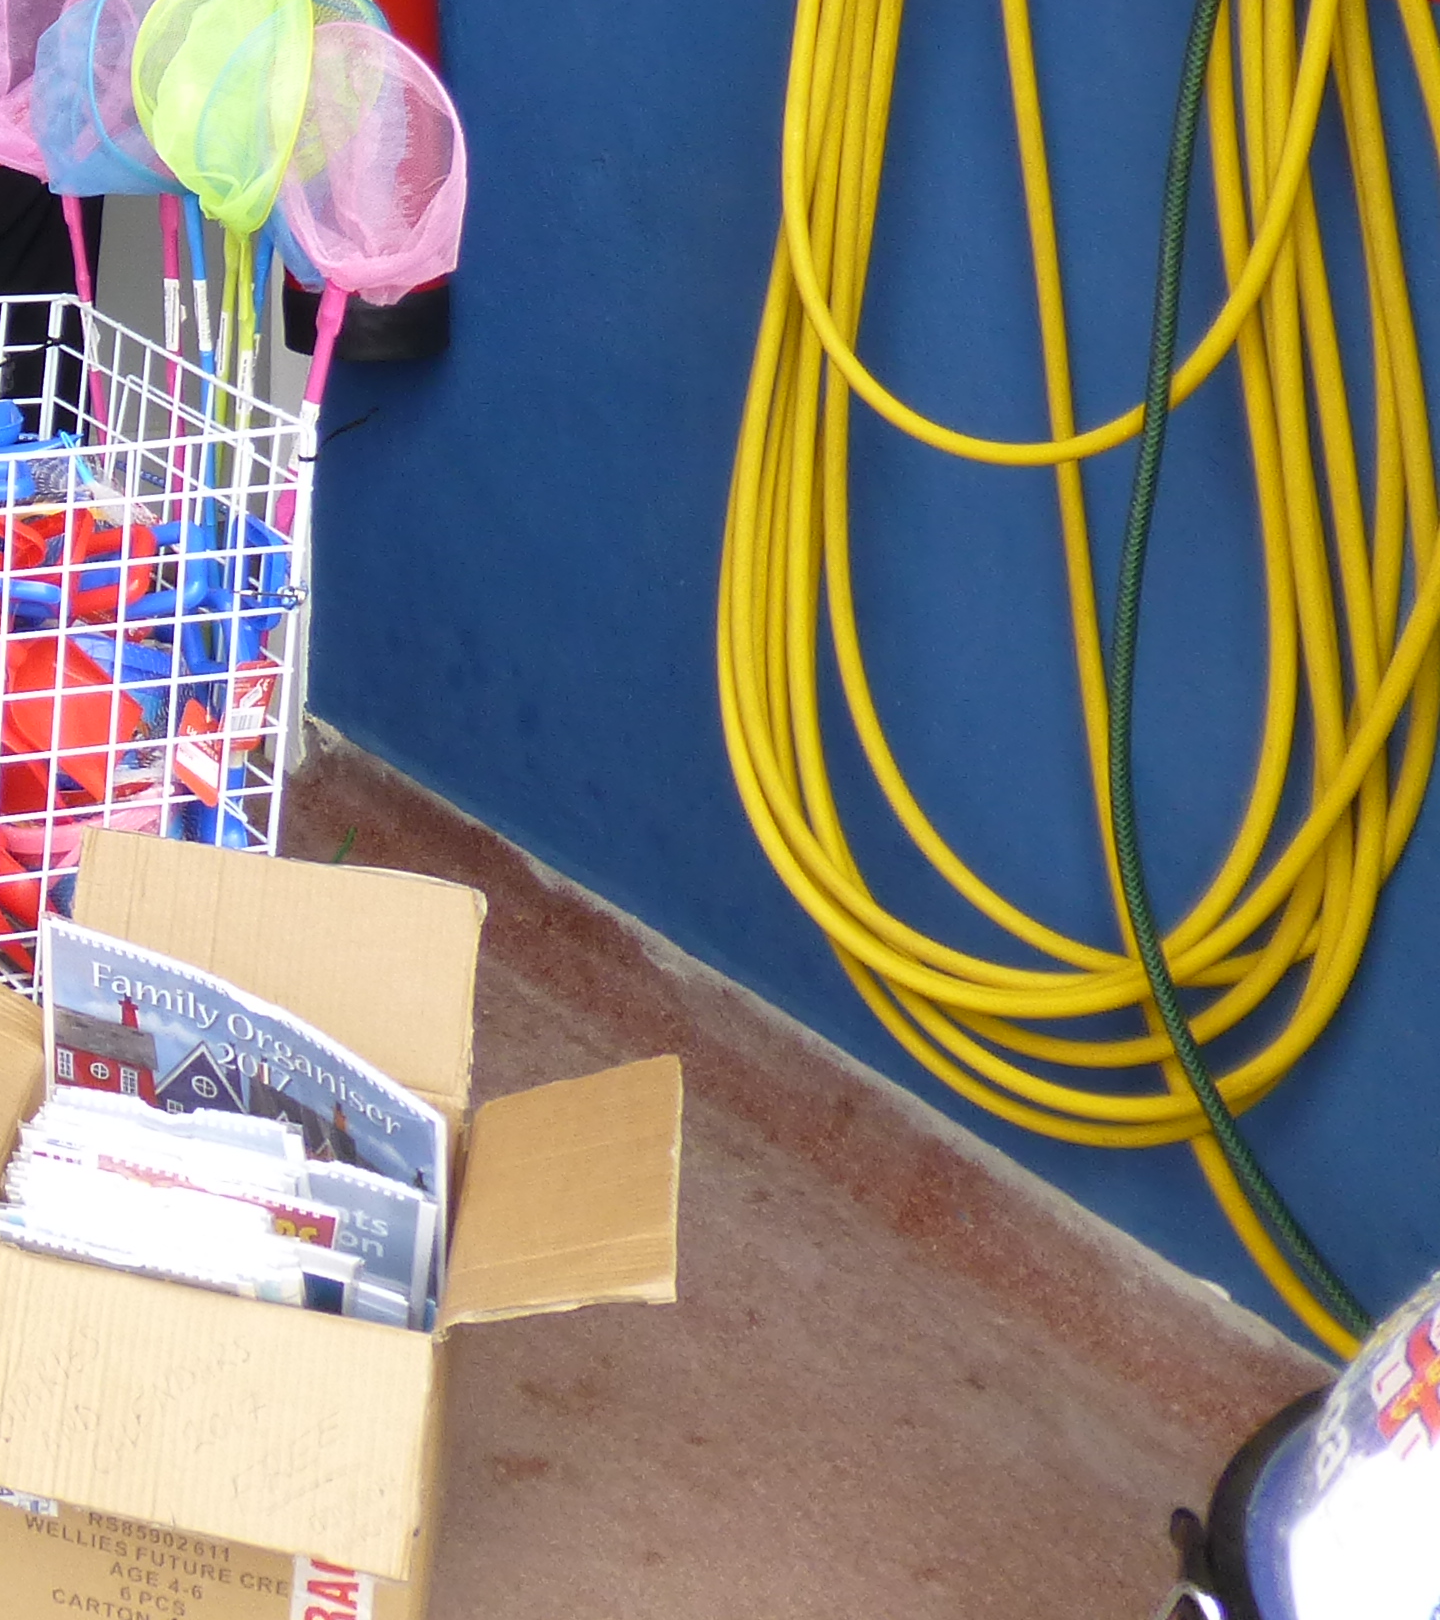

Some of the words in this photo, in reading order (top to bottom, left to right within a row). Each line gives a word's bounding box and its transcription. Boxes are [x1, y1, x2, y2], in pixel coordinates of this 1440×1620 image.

[91, 960, 219, 1030] Family
[226, 1011, 403, 1136] Organiser
[217, 1041, 294, 1094] 2017
[24, 1513, 129, 1558] WELLIES
[135, 1546, 233, 1587] FUTURE
[239, 1572, 290, 1599] CRE
[108, 1562, 160, 1589] AGE
[167, 1579, 204, 1601] 4-6
[119, 1586, 132, 1601] 6
[138, 1590, 186, 1617] PCS
